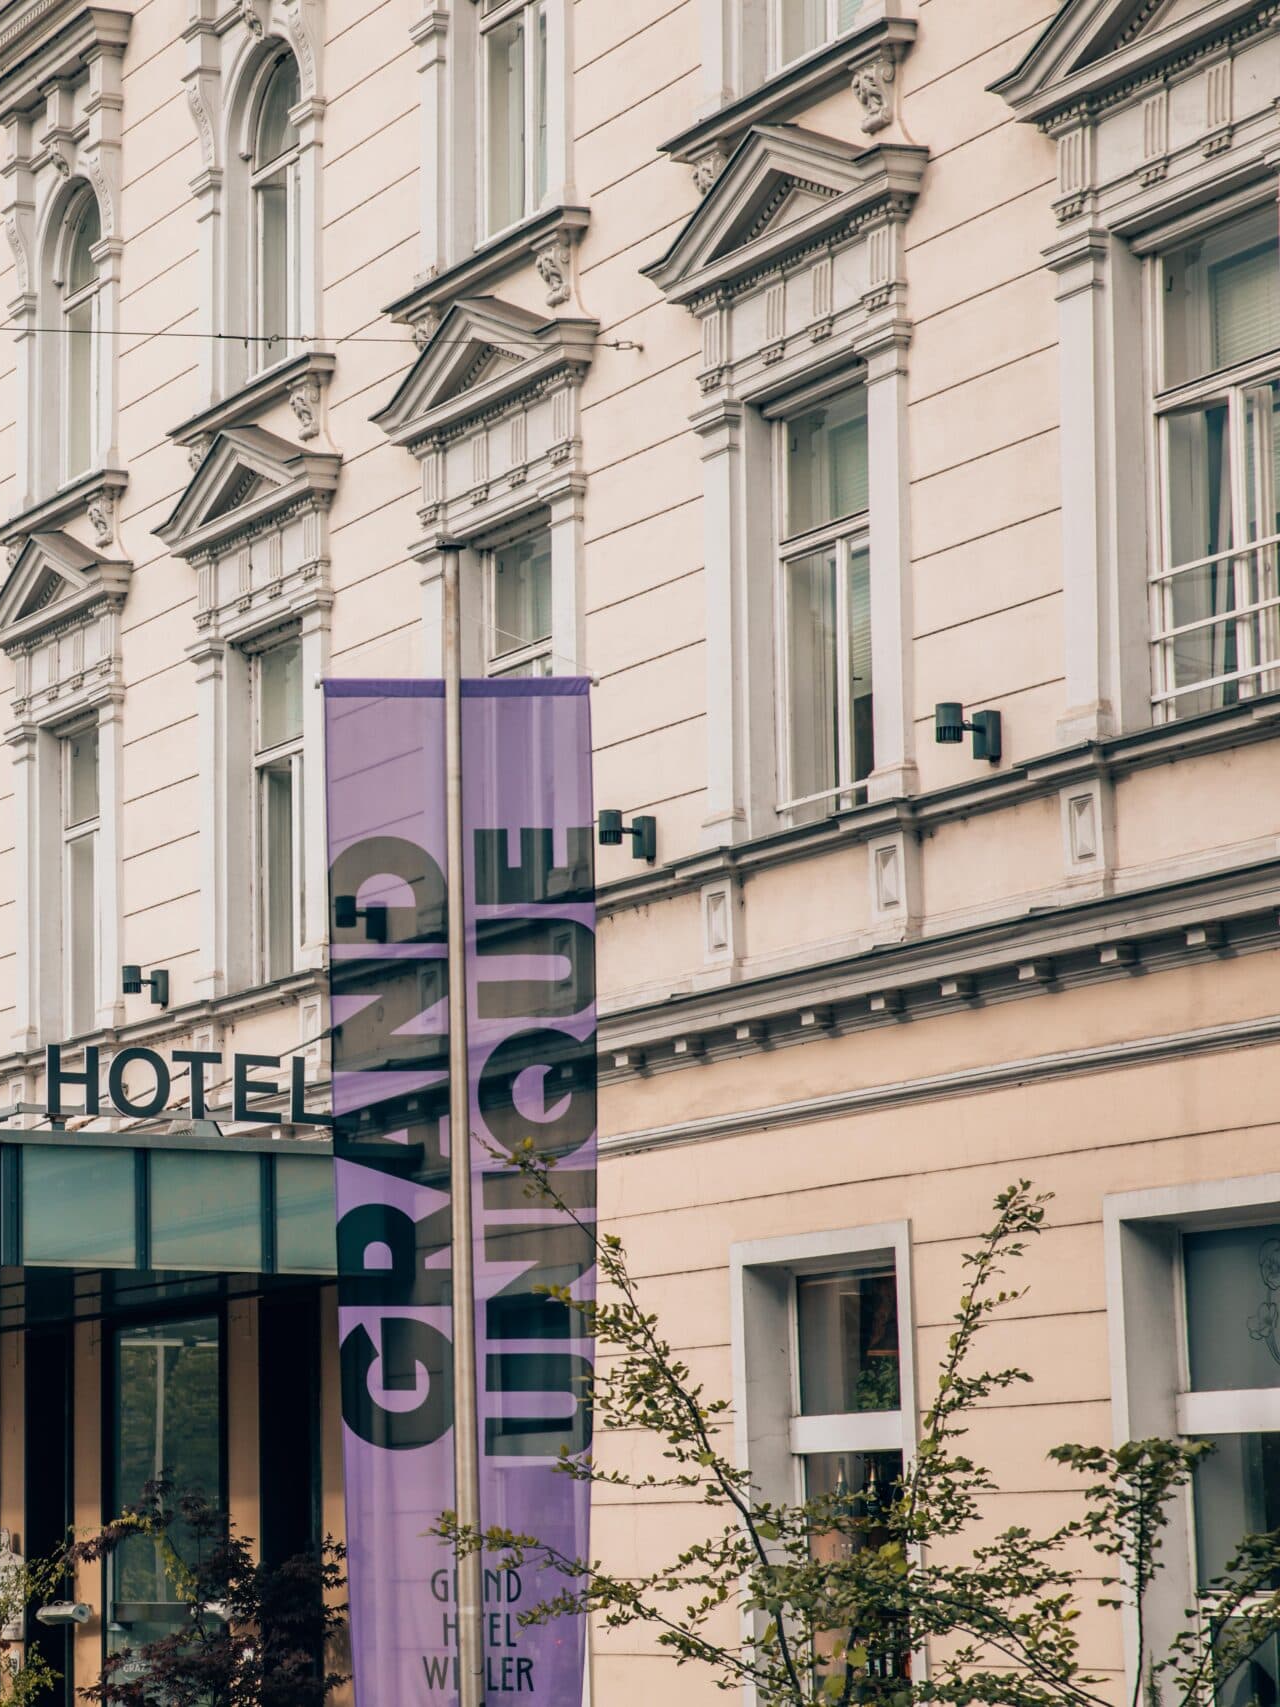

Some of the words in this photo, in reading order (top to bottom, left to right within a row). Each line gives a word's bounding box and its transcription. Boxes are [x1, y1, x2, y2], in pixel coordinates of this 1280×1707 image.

[46, 1044, 334, 1126] HOTEL
[329, 836, 453, 1450] GRAND
[473, 828, 597, 1456] UNIQUE
[431, 1568, 522, 1603] GND
[443, 1613, 517, 1647] HEL
[422, 1655, 534, 1692] WILER
